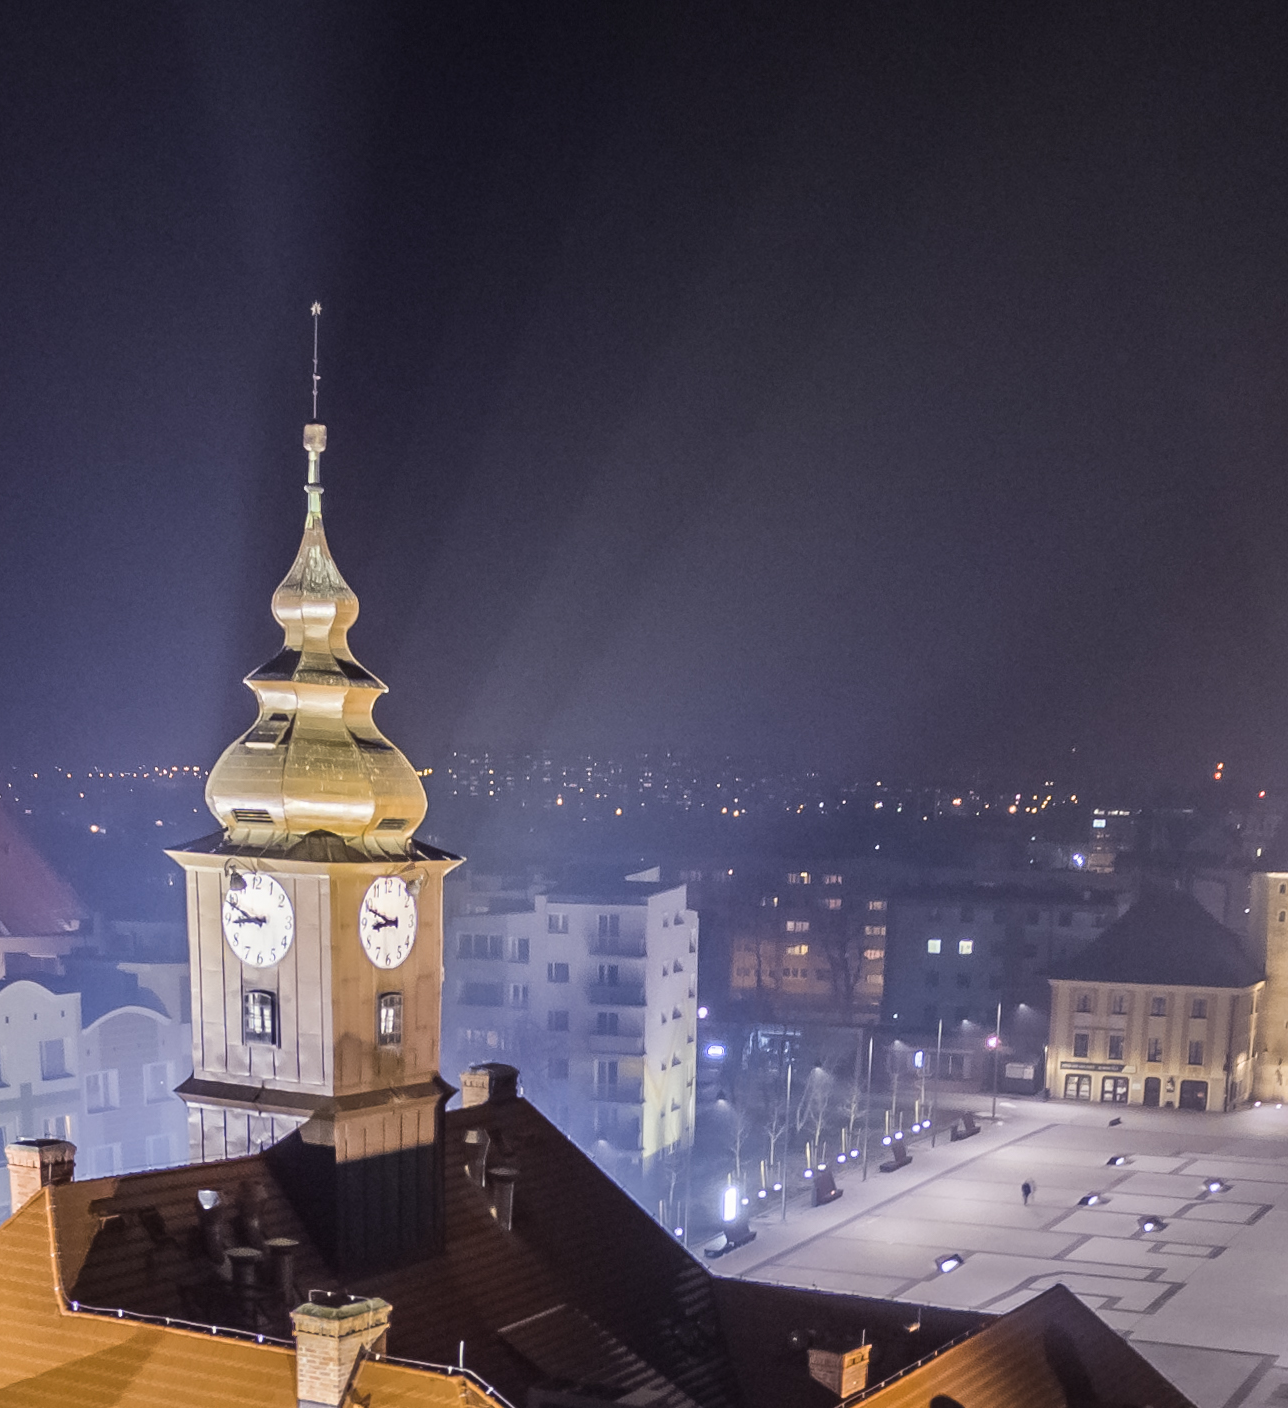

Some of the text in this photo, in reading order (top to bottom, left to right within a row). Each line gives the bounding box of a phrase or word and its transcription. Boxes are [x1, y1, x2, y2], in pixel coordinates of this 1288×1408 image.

[252, 875, 263, 890] 12
[384, 879, 393, 894] 12
[373, 884, 380, 898] 11
[278, 893, 286, 908] 2
[224, 912, 232, 926] 9
[284, 915, 293, 930] 3
[361, 917, 368, 931] 9
[408, 914, 414, 929] 3
[232, 932, 240, 947] 8
[280, 935, 288, 950] 4
[366, 934, 372, 950] 8
[404, 934, 410, 949] 4
[244, 945, 252, 960] 7
[256, 951, 264, 965] 6
[269, 948, 276, 962] 5
[375, 946, 381, 961] 7
[385, 952, 392, 966] 6
[396, 945, 402, 960] 5
